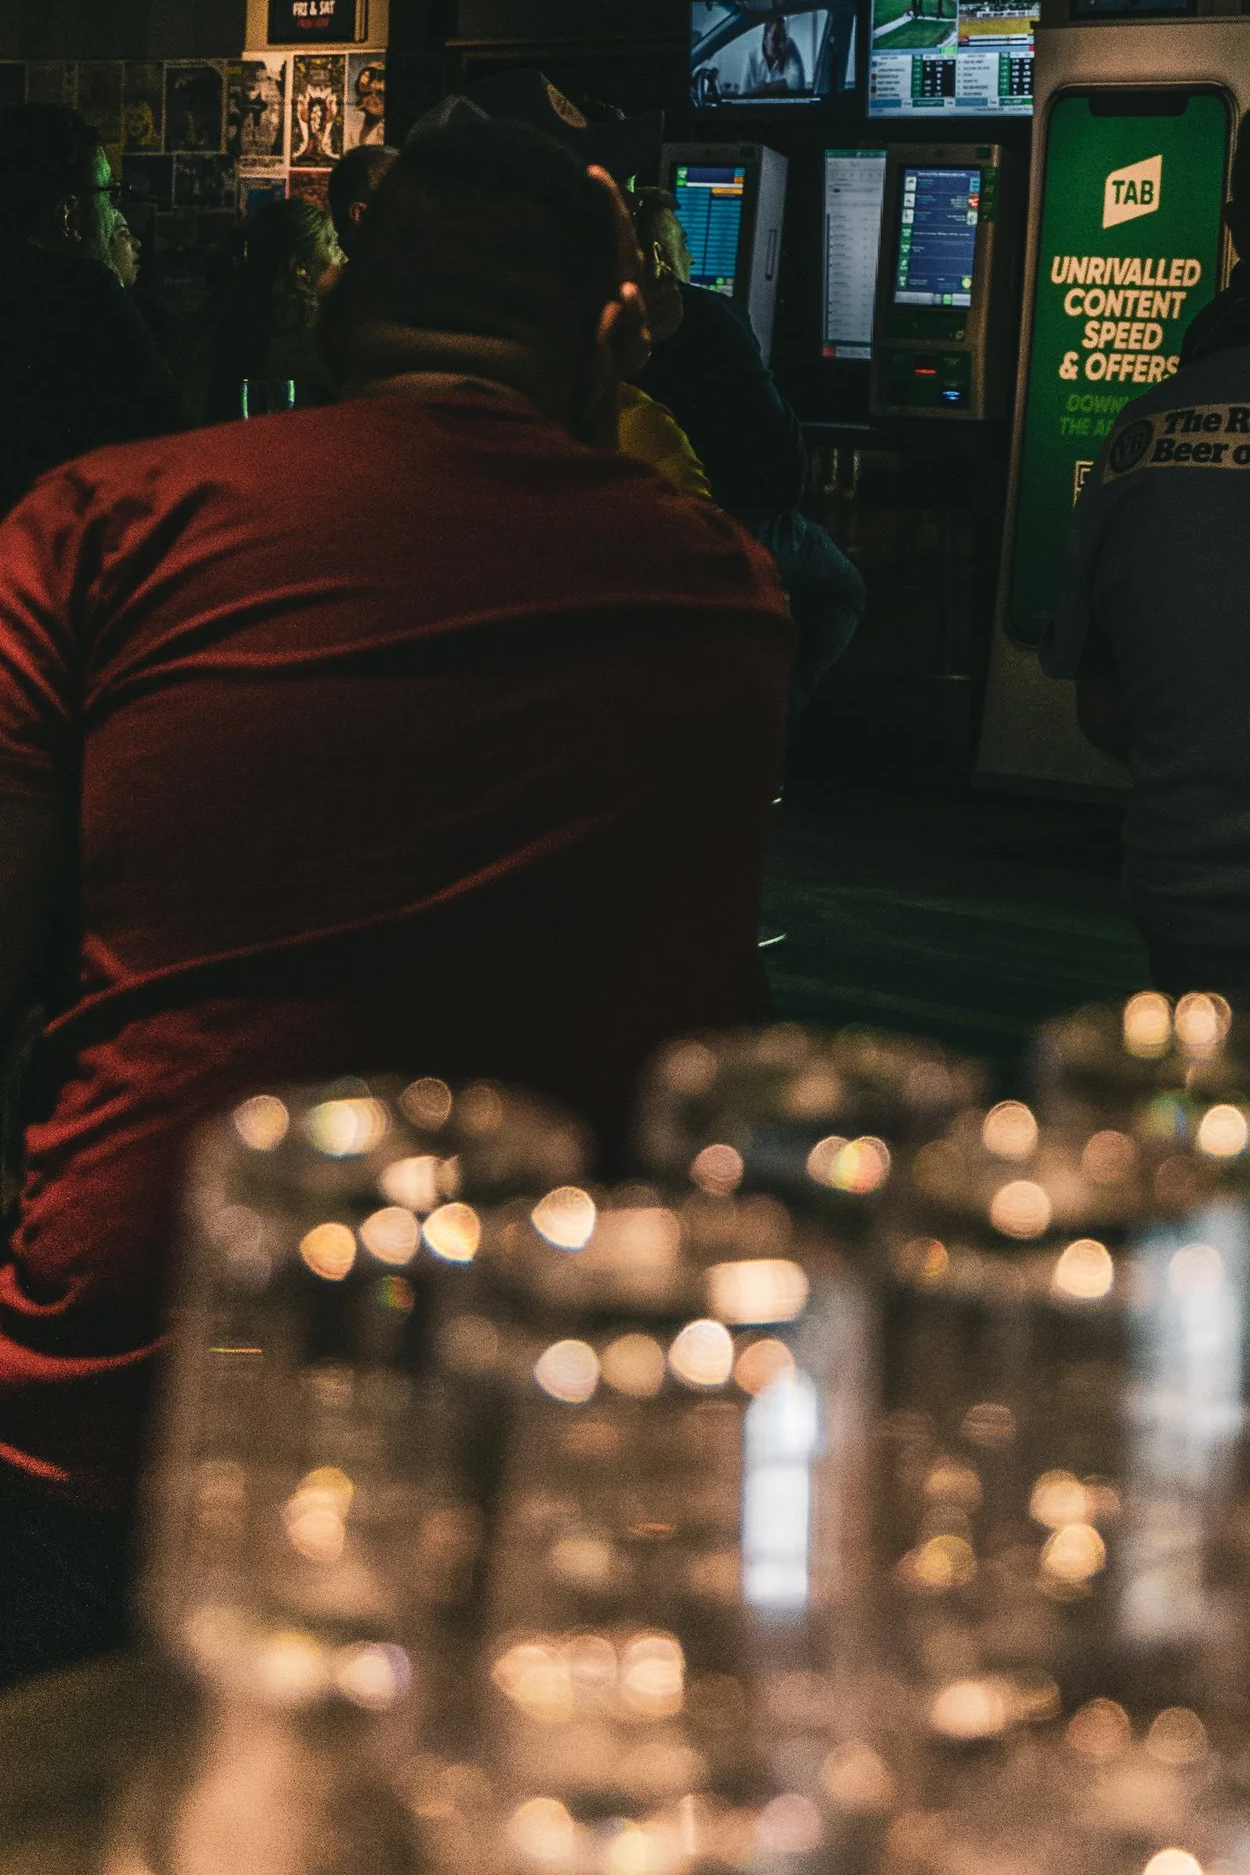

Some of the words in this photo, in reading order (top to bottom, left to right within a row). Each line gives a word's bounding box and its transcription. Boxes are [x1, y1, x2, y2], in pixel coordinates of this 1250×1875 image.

[292, 1, 308, 17] FRI
[319, 0, 336, 15] SAT
[1111, 180, 1154, 205] TAB
[1050, 255, 1202, 287] UNRIVALLED
[1062, 288, 1187, 319] CONTENT
[1081, 320, 1163, 350] SPEED
[1058, 351, 1079, 381] &
[1084, 352, 1180, 384] OFFERS
[1059, 416, 1093, 435] THE
[1163, 409, 1221, 435] The
[1150, 438, 1229, 465] Beer
